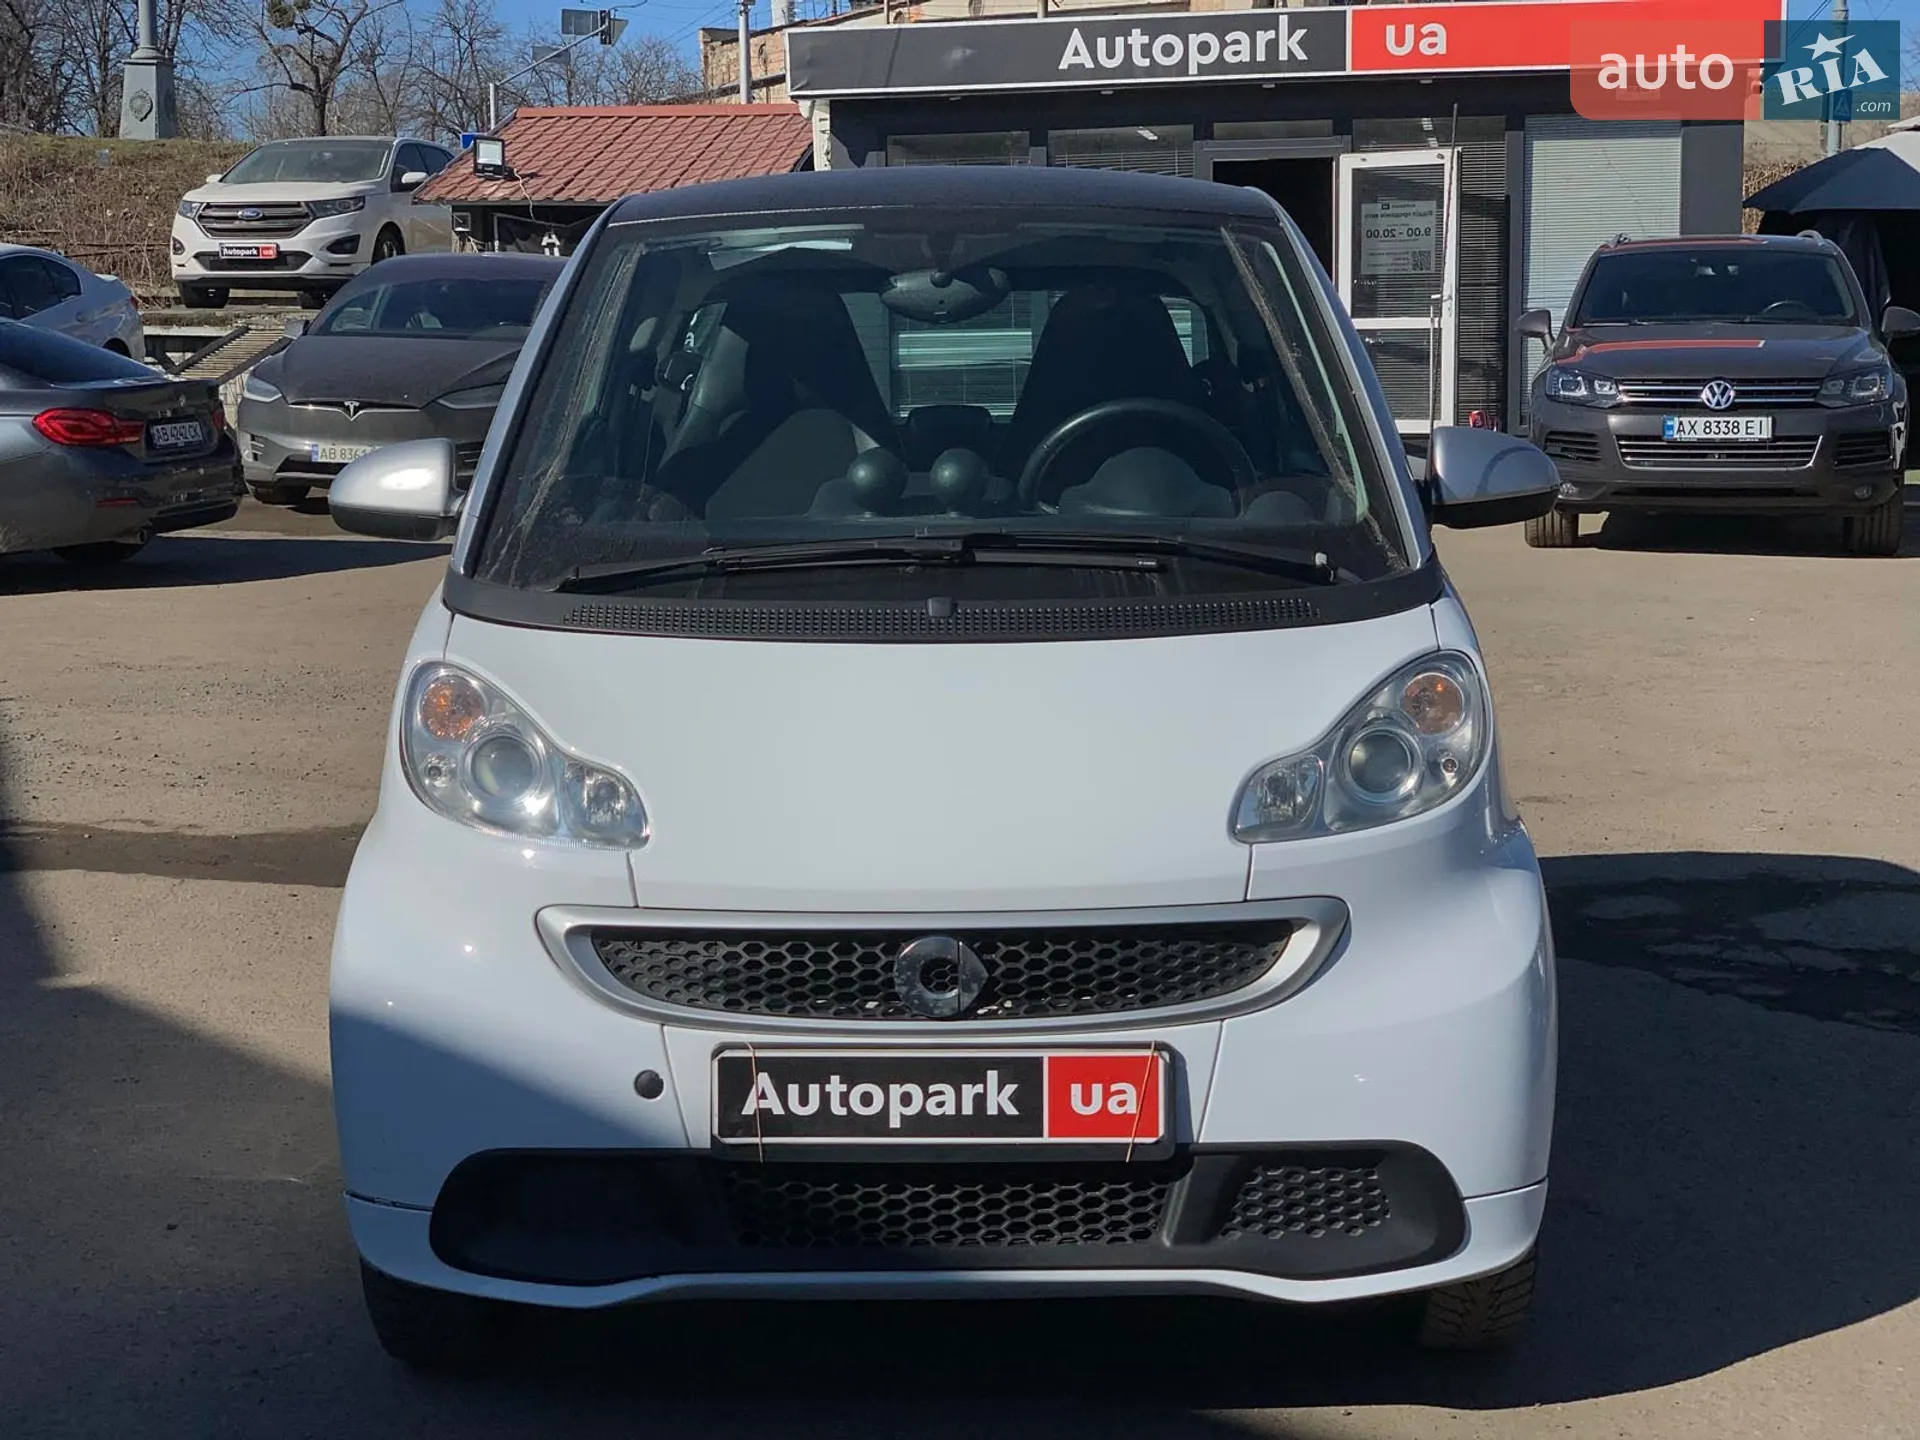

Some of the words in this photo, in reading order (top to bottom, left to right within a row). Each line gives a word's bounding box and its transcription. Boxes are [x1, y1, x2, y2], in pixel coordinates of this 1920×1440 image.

[1058, 14, 1309, 75] Autopark
[1385, 22, 1447, 56] ua
[1676, 420, 1698, 435] AX
[1702, 420, 1740, 436] 8338
[1745, 420, 1763, 436] EI
[320, 447, 337, 460] AB
[340, 447, 366, 460] 836
[741, 1070, 1020, 1128] Autopark
[1070, 1081, 1139, 1115] ua
